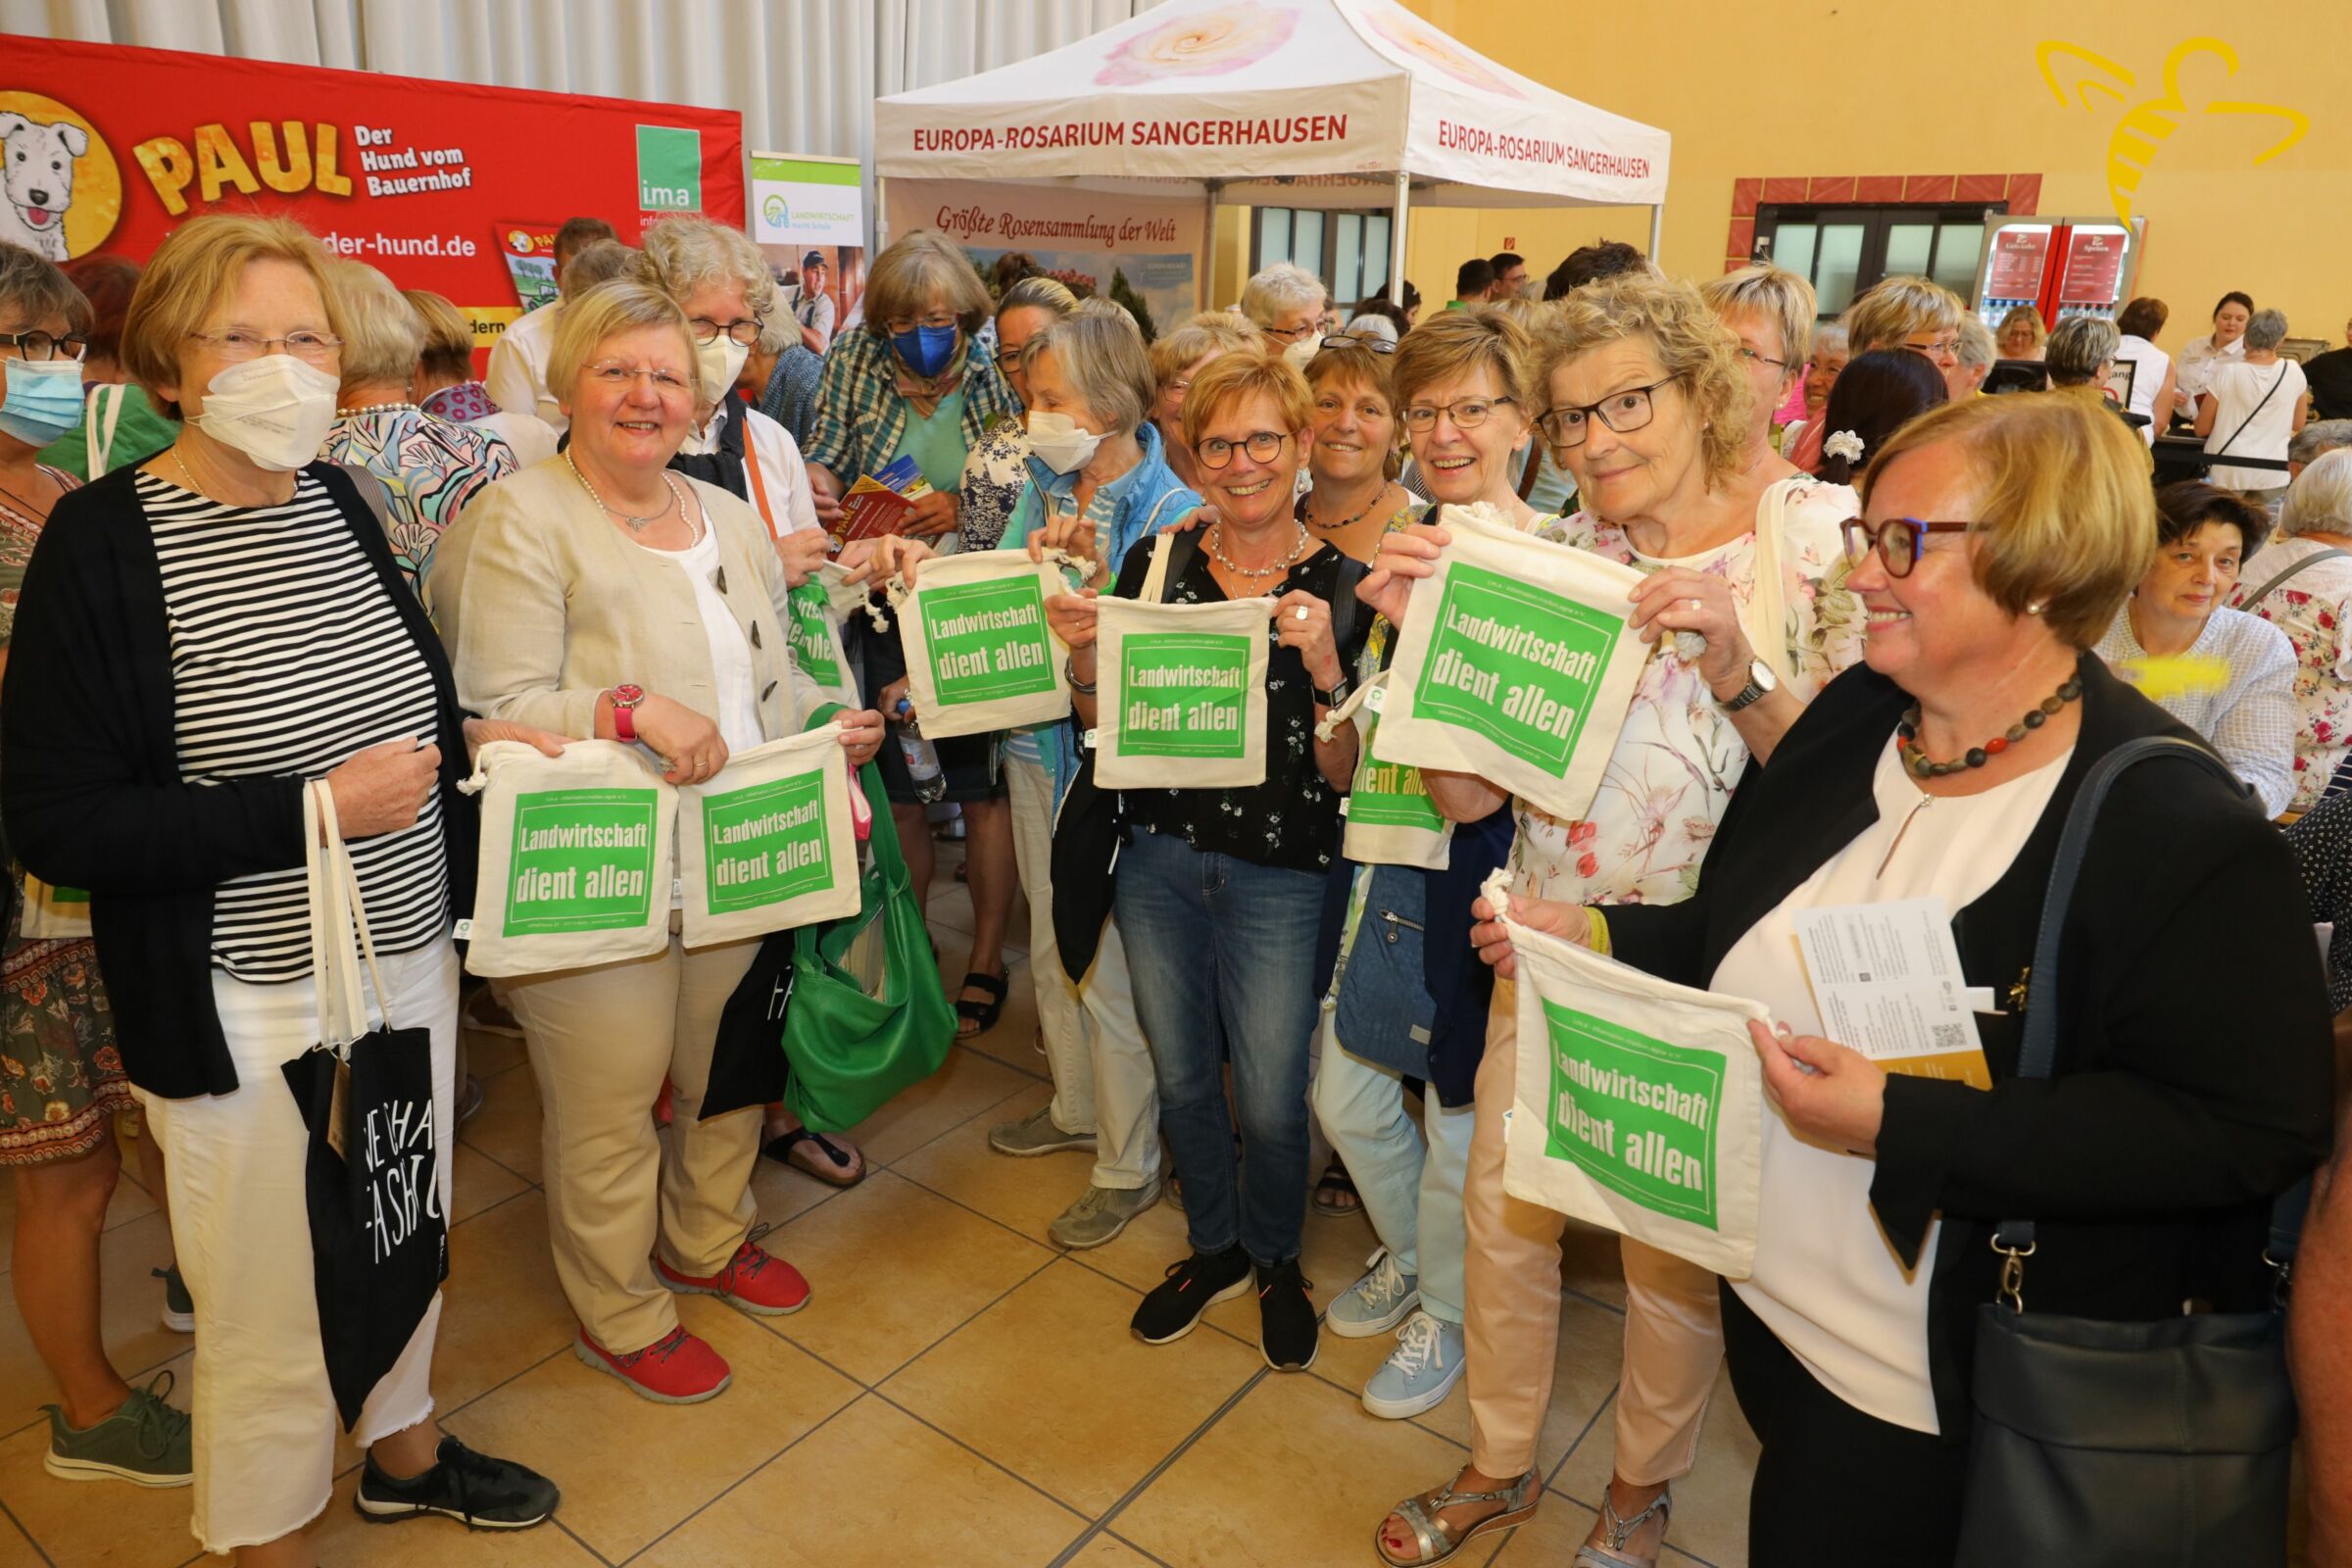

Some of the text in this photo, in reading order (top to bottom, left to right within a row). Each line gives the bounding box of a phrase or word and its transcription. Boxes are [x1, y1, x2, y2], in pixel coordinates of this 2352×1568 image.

[354, 124, 392, 147] Der
[913, 114, 1348, 151] EUROPA-ROSARIUM SANGERHAUSEN
[1439, 120, 1650, 178] EUROPA-ROSARIUM SANGERHAUSEN
[132, 121, 353, 216] PAUL
[360, 147, 464, 172] Hund vom
[367, 167, 471, 198] Bauernhof
[321, 231, 476, 258] der-hund.de
[936, 205, 1176, 248] Größte Rosensammlung der Welt
[468, 318, 506, 334] dern
[930, 603, 1039, 642] Landwirtschaft
[938, 640, 1047, 681] dient allen
[1446, 604, 1597, 685] Landwirtschaft
[1129, 663, 1244, 690] Landwirtschaft
[1431, 647, 1500, 707] dient
[1501, 683, 1576, 741] allen
[1128, 701, 1238, 732] dient allen
[1354, 762, 1397, 795] ient
[519, 822, 647, 853] Landwirtschaft
[712, 799, 820, 845] Landwirtschaft
[715, 837, 823, 887] dient allen
[514, 863, 644, 904] dient allen
[1553, 1040, 1709, 1131] Landwirtschaft
[1557, 1090, 1616, 1159] dient
[1625, 1130, 1702, 1192] allen
